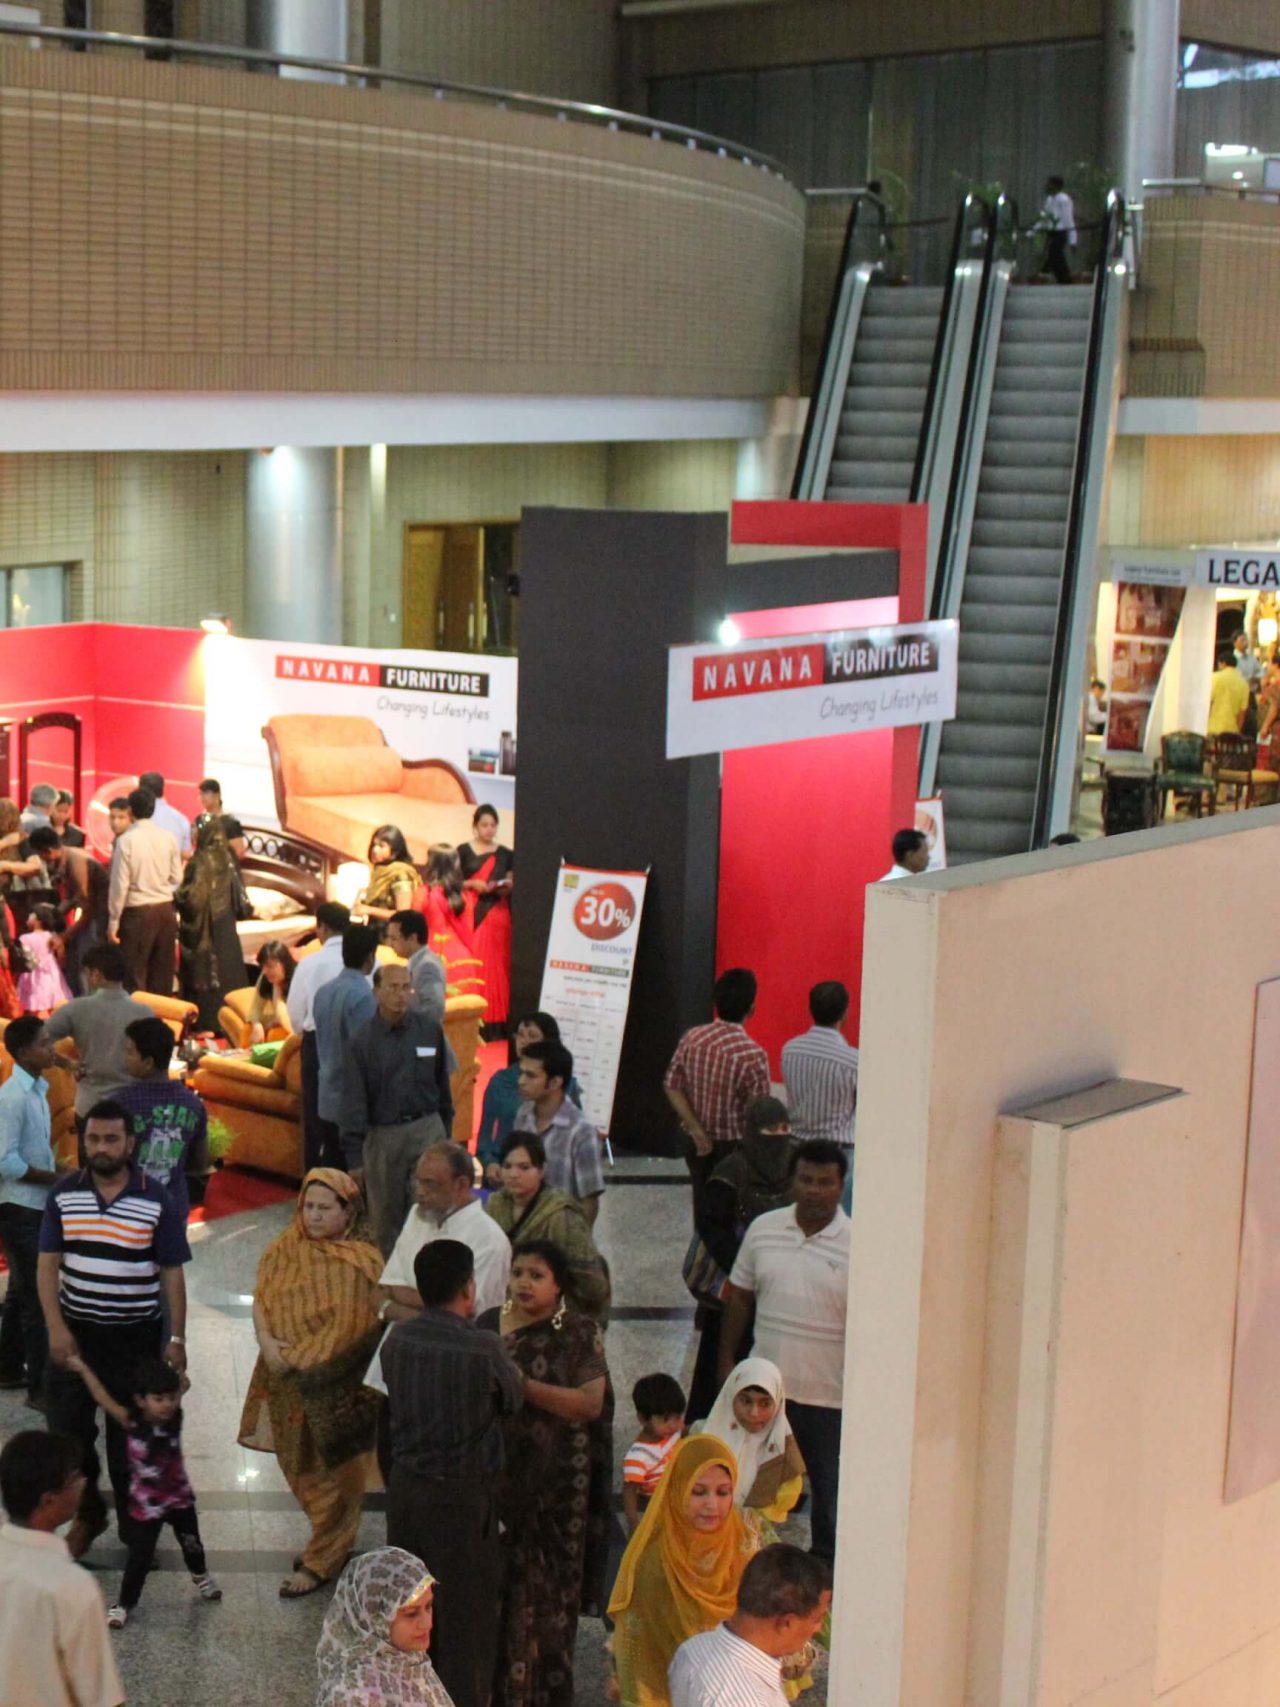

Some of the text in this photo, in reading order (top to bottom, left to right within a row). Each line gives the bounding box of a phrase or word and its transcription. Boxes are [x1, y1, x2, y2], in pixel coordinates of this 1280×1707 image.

[282, 658, 481, 694] NAVANA FURNITURE
[703, 642, 931, 691] NAVANA FURNITURE
[376, 695, 491, 724] Changing Lifestyles
[820, 688, 940, 723] Changing Lifestyles
[580, 895, 631, 928] 30%
